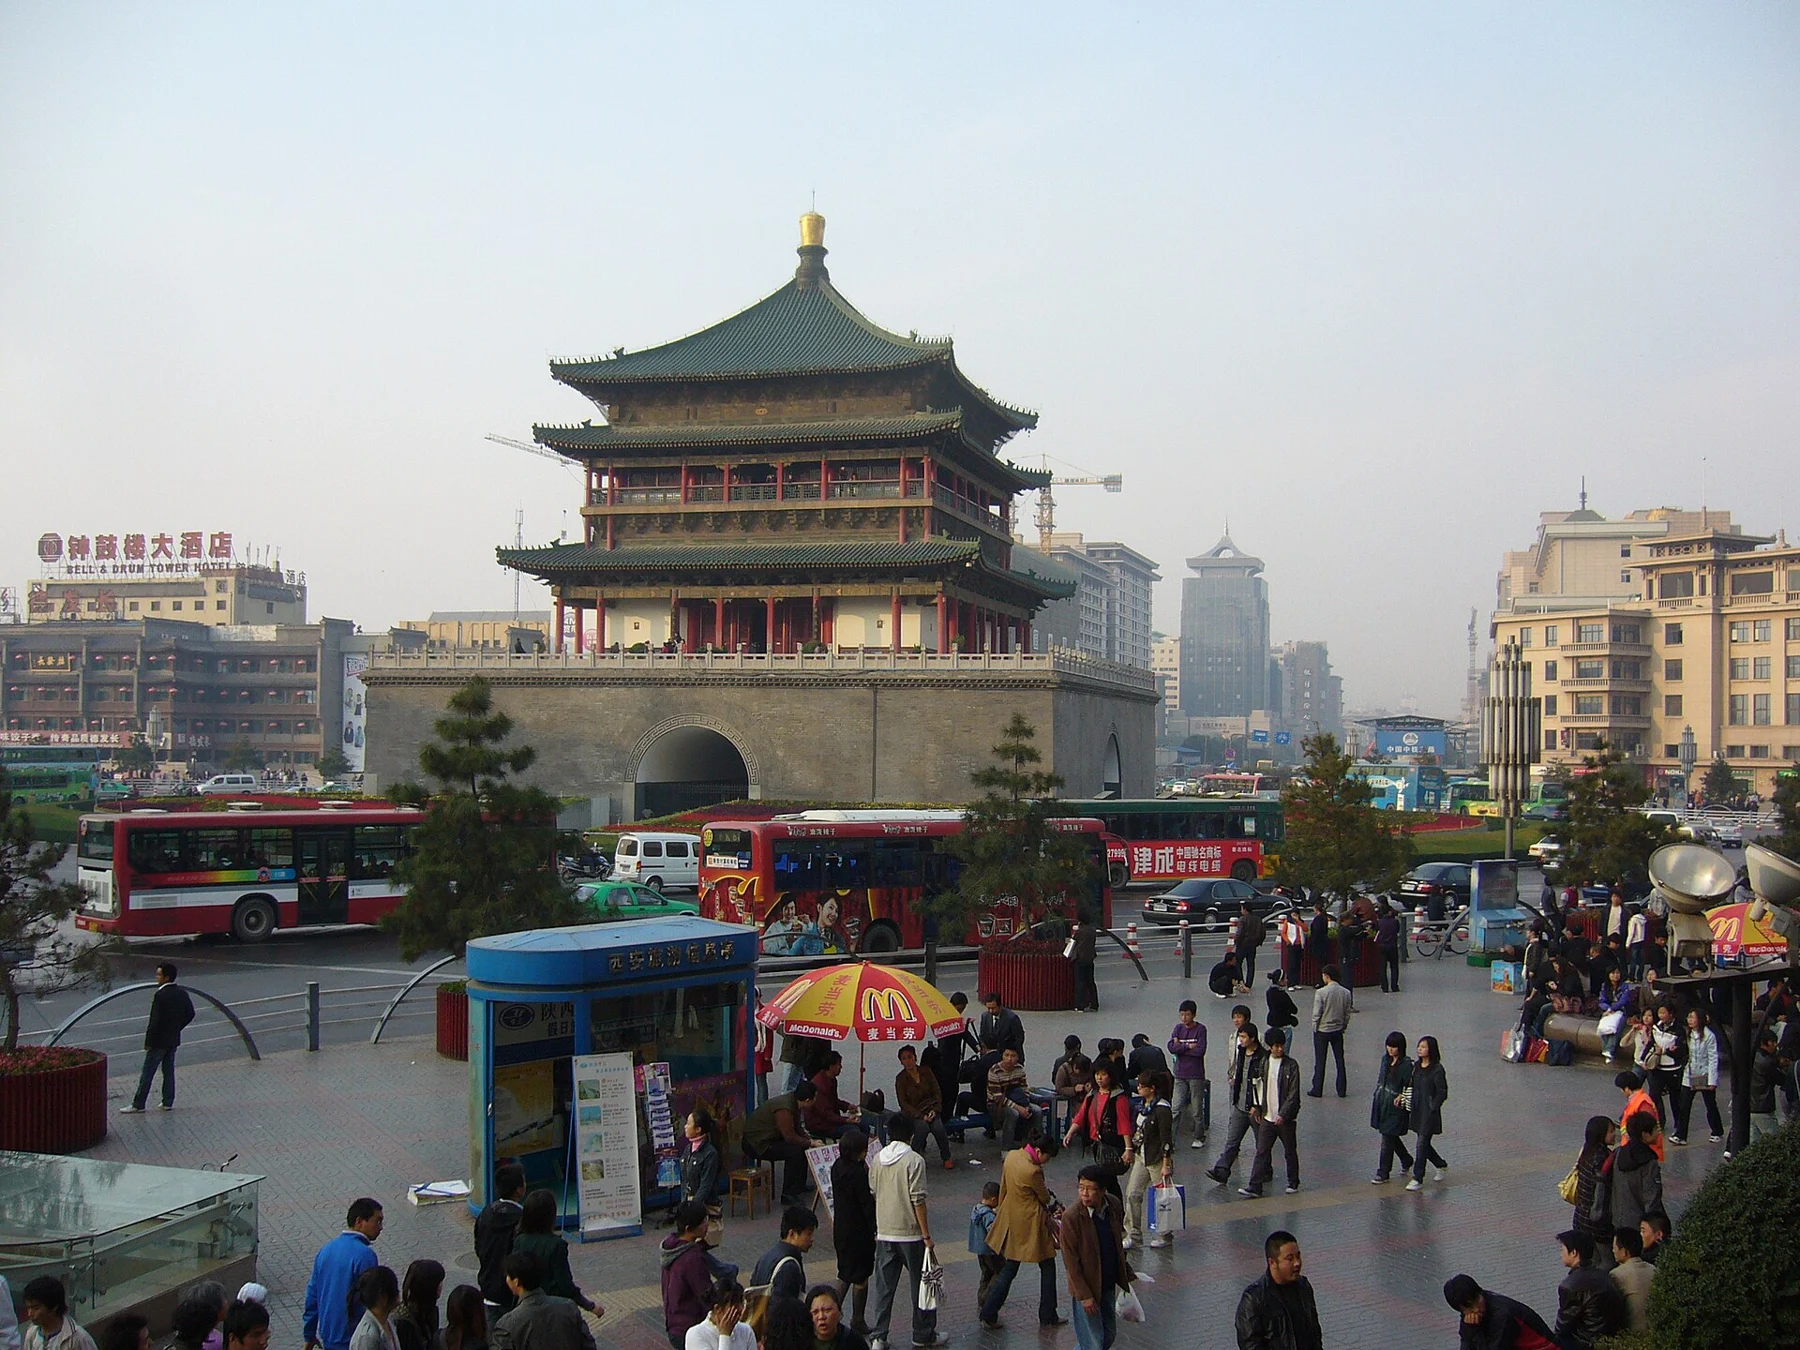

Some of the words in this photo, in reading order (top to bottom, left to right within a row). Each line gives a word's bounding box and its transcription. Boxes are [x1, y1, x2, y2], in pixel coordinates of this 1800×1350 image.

[68, 531, 232, 561] 钟鼓楼大酒店
[67, 565, 95, 575] BELL
[100, 565, 107, 574] &
[112, 563, 145, 574] DRUM
[150, 563, 189, 574] TOWER
[194, 561, 233, 573] HOTEL
[1176, 846, 1221, 859] 中国驰名商标
[1133, 846, 1174, 875] 津成
[1176, 860, 1221, 873] 电线电缆
[547, 1020, 575, 1037] 假日
